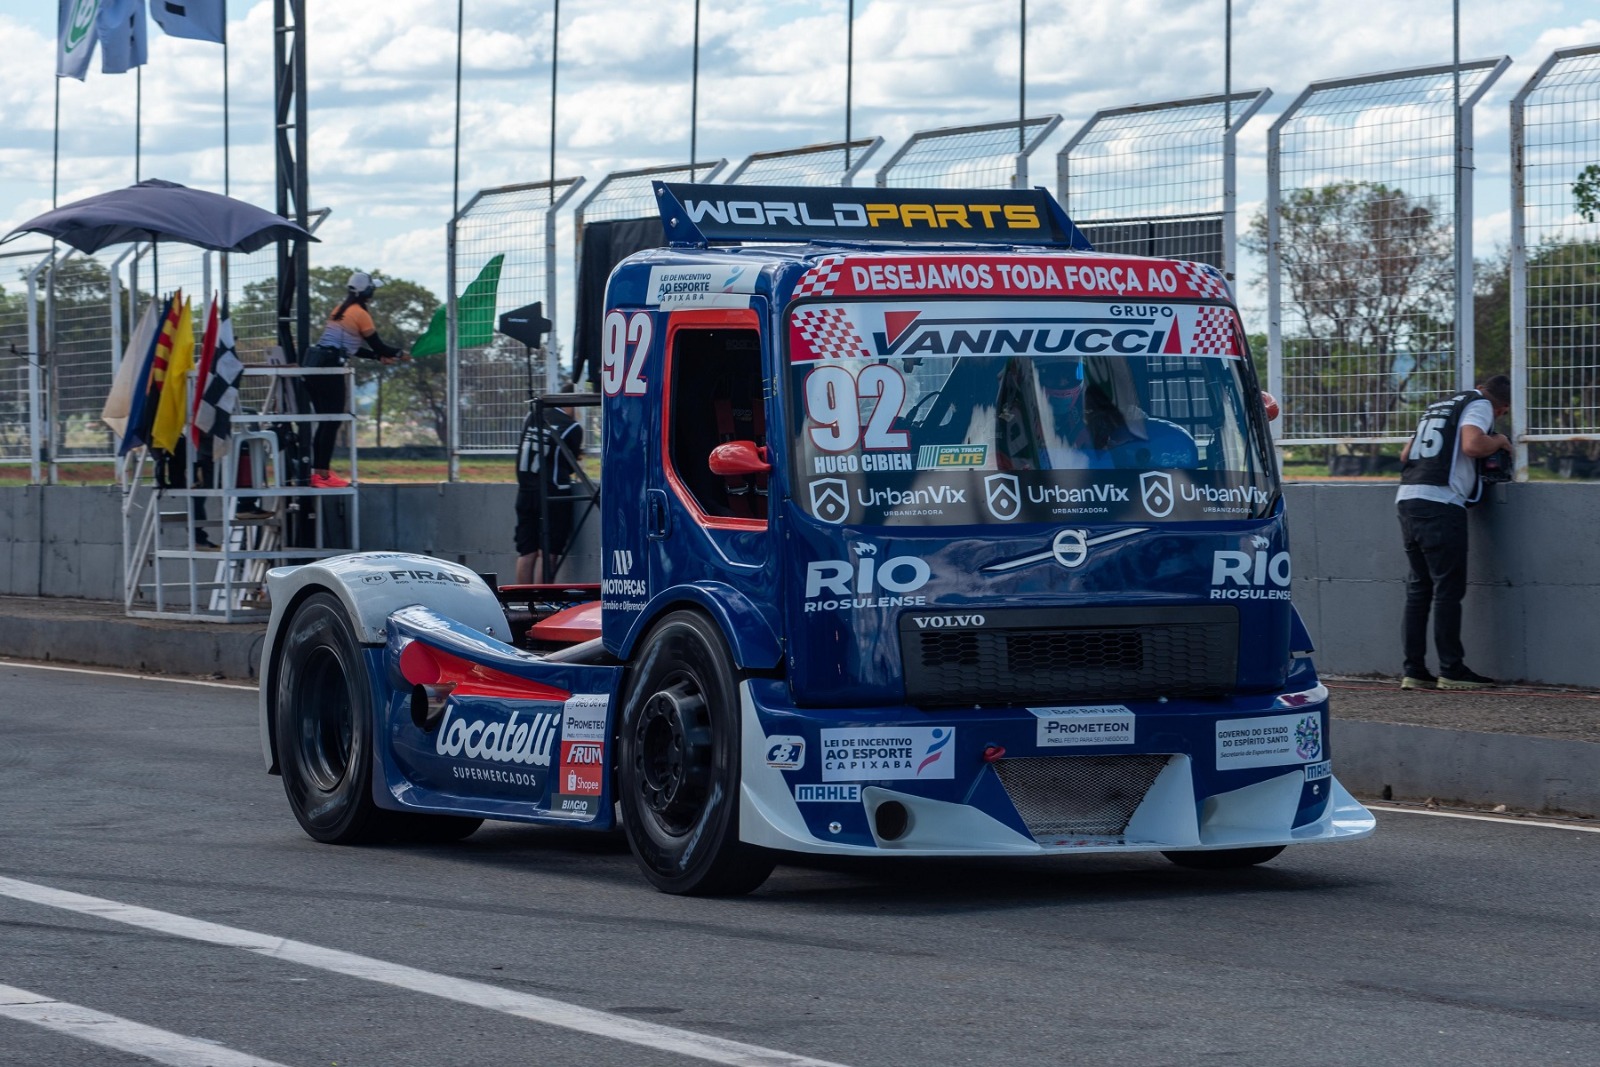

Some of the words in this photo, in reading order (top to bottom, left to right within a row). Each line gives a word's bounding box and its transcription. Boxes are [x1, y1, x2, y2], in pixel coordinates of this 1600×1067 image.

[683, 199, 1041, 229] WORLDPARTS
[677, 273, 711, 281] INCENTIVO
[850, 264, 994, 291] DESEJAMOS
[996, 264, 1063, 290] TODA
[1064, 265, 1143, 296] FORÇA
[1148, 267, 1178, 293] AO
[659, 282, 672, 293] AO
[674, 281, 710, 292] ESPORTE
[1109, 304, 1174, 317] GRUPO
[871, 318, 1166, 356] VANNUCCI
[603, 308, 654, 397] 92
[803, 363, 911, 454] 92
[1408, 418, 1447, 460] 15
[813, 454, 859, 474] HUGO
[861, 453, 913, 472] CIBIEN
[938, 453, 984, 465] ELITE
[857, 485, 967, 507] UrbanVix
[1027, 483, 1130, 504] UrbanVix
[1180, 483, 1269, 505] UrbanVix
[883, 509, 943, 517] URBANIZADORA
[1052, 506, 1109, 514] URBANIZADORA
[1202, 506, 1253, 514] URBANIZADORA
[389, 570, 470, 584] FIRAD
[805, 554, 931, 598] RIO
[1210, 589, 1292, 601] RIOSULENSE
[804, 595, 926, 613] RIOSULENSE
[912, 614, 986, 629] VOLVO
[1217, 729, 1251, 739] GOVERNO
[1251, 728, 1262, 736] DO
[1263, 726, 1289, 736] ESTADO
[824, 739, 840, 748] LEI
[841, 739, 855, 747] DE
[857, 738, 913, 747] INCENTIVO
[1222, 739, 1233, 748] DO
[1234, 737, 1266, 747] ESPÍRITO
[1266, 735, 1289, 744] SANTO
[566, 743, 603, 764] FRUM
[766, 744, 802, 763] CBA
[825, 749, 849, 761] AO
[852, 747, 913, 760] ESPORTE
[825, 760, 913, 771] CAPIXABA
[452, 766, 536, 787] SUPERMERCADOS
[576, 776, 599, 793] Shopee
[798, 786, 858, 801] MAHLE
[561, 799, 588, 811] BIAGIO
